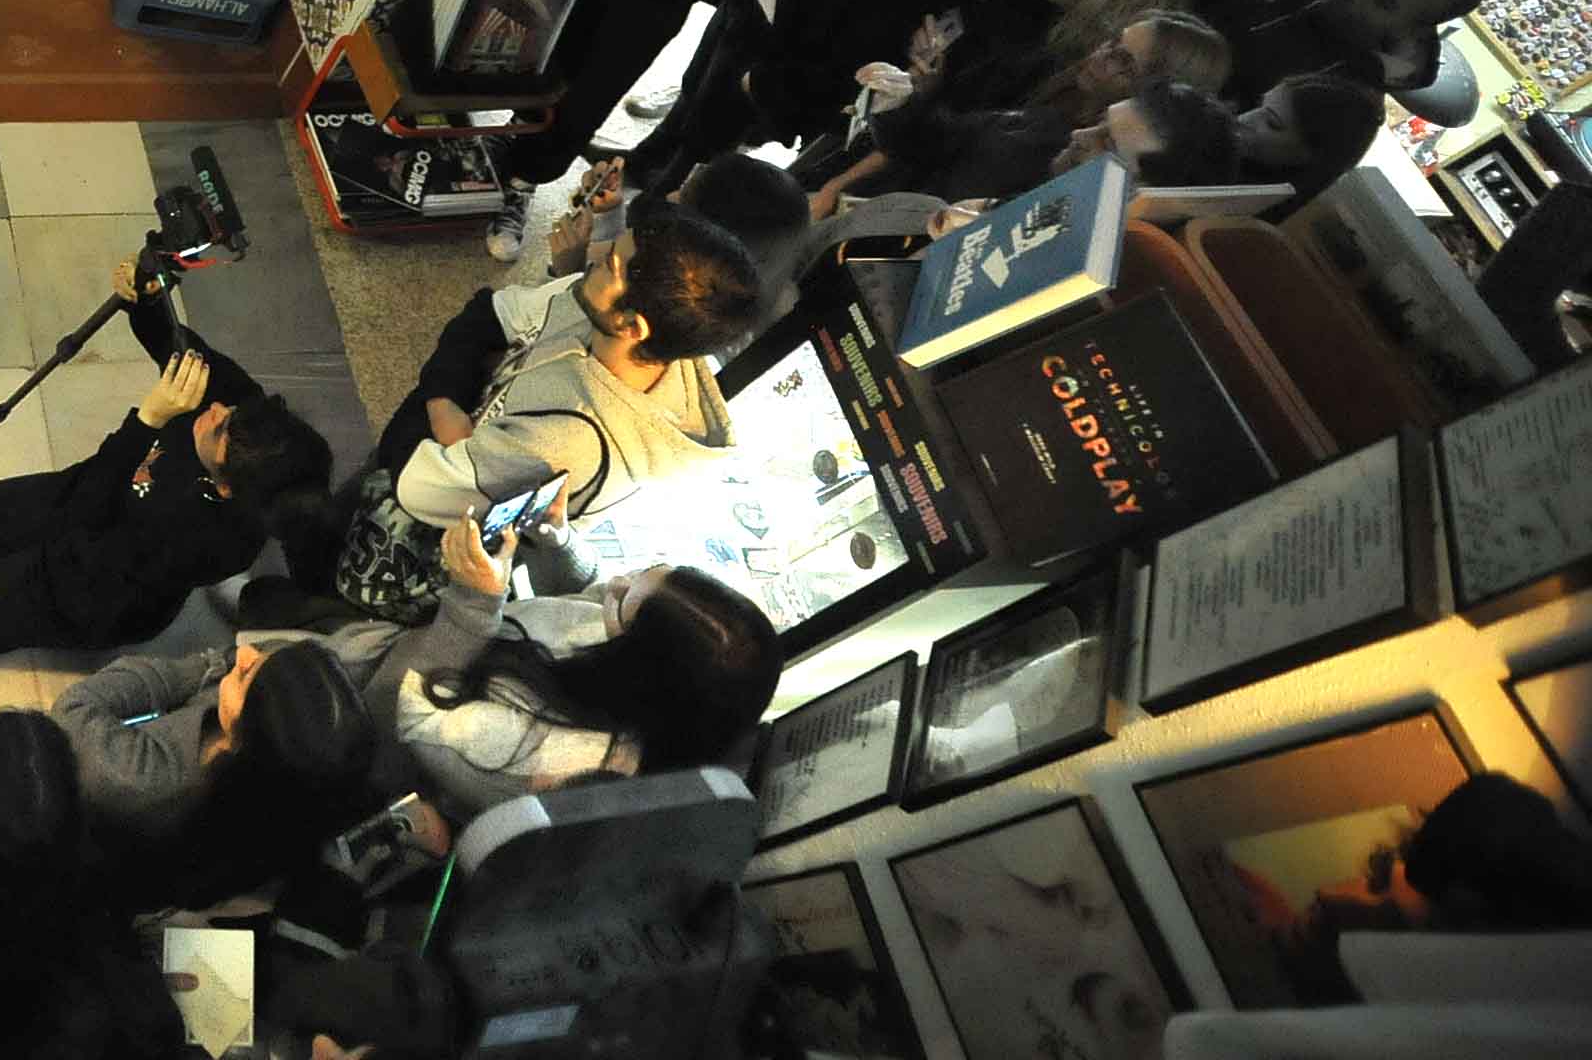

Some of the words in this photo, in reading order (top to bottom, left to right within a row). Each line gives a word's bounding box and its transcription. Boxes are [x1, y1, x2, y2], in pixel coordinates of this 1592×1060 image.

[198, 170, 224, 213] RODE
[839, 333, 883, 408] SOUVENIRS
[1041, 355, 1144, 515] COLDPLAY
[899, 462, 949, 545] SOUVENIRS
